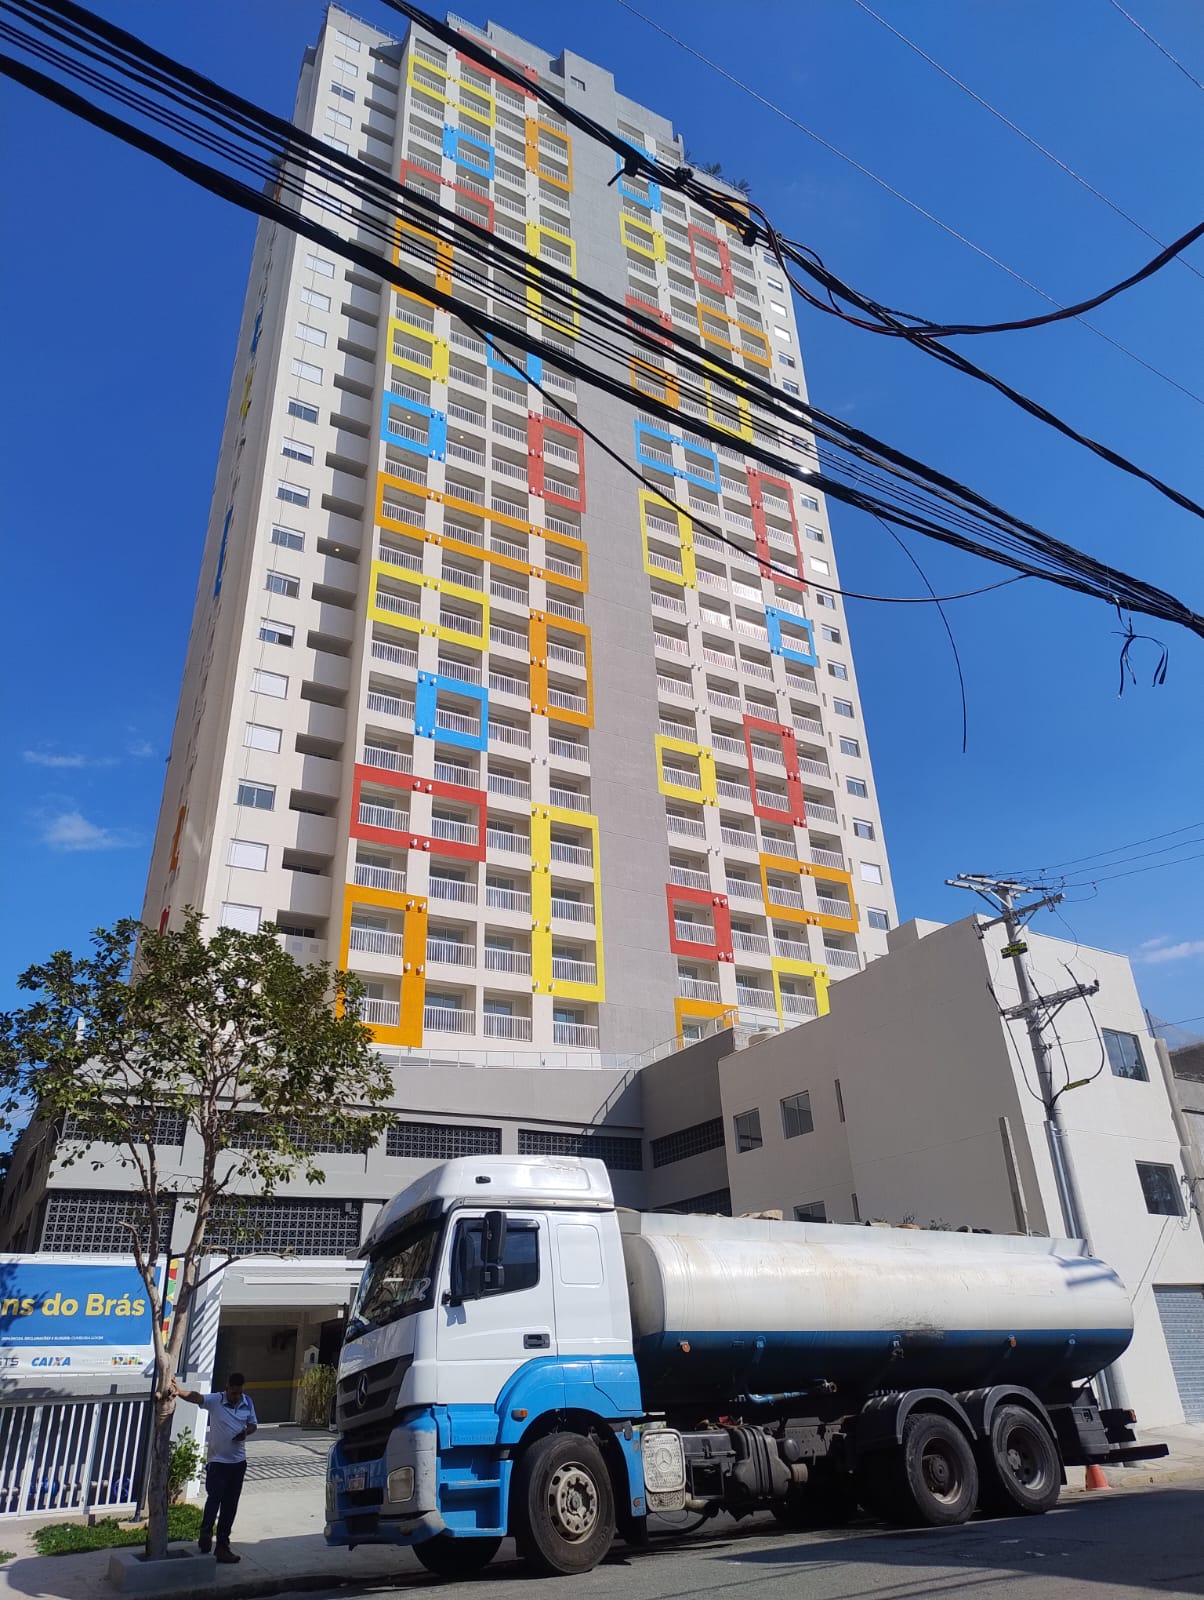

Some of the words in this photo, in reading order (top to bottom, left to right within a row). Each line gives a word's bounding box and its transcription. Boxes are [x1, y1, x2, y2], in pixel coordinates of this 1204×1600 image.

[0, 1298, 35, 1316] ns
[41, 1292, 79, 1316] do
[85, 1293, 146, 1316] Brás
[31, 1356, 71, 1367] CAIXA
